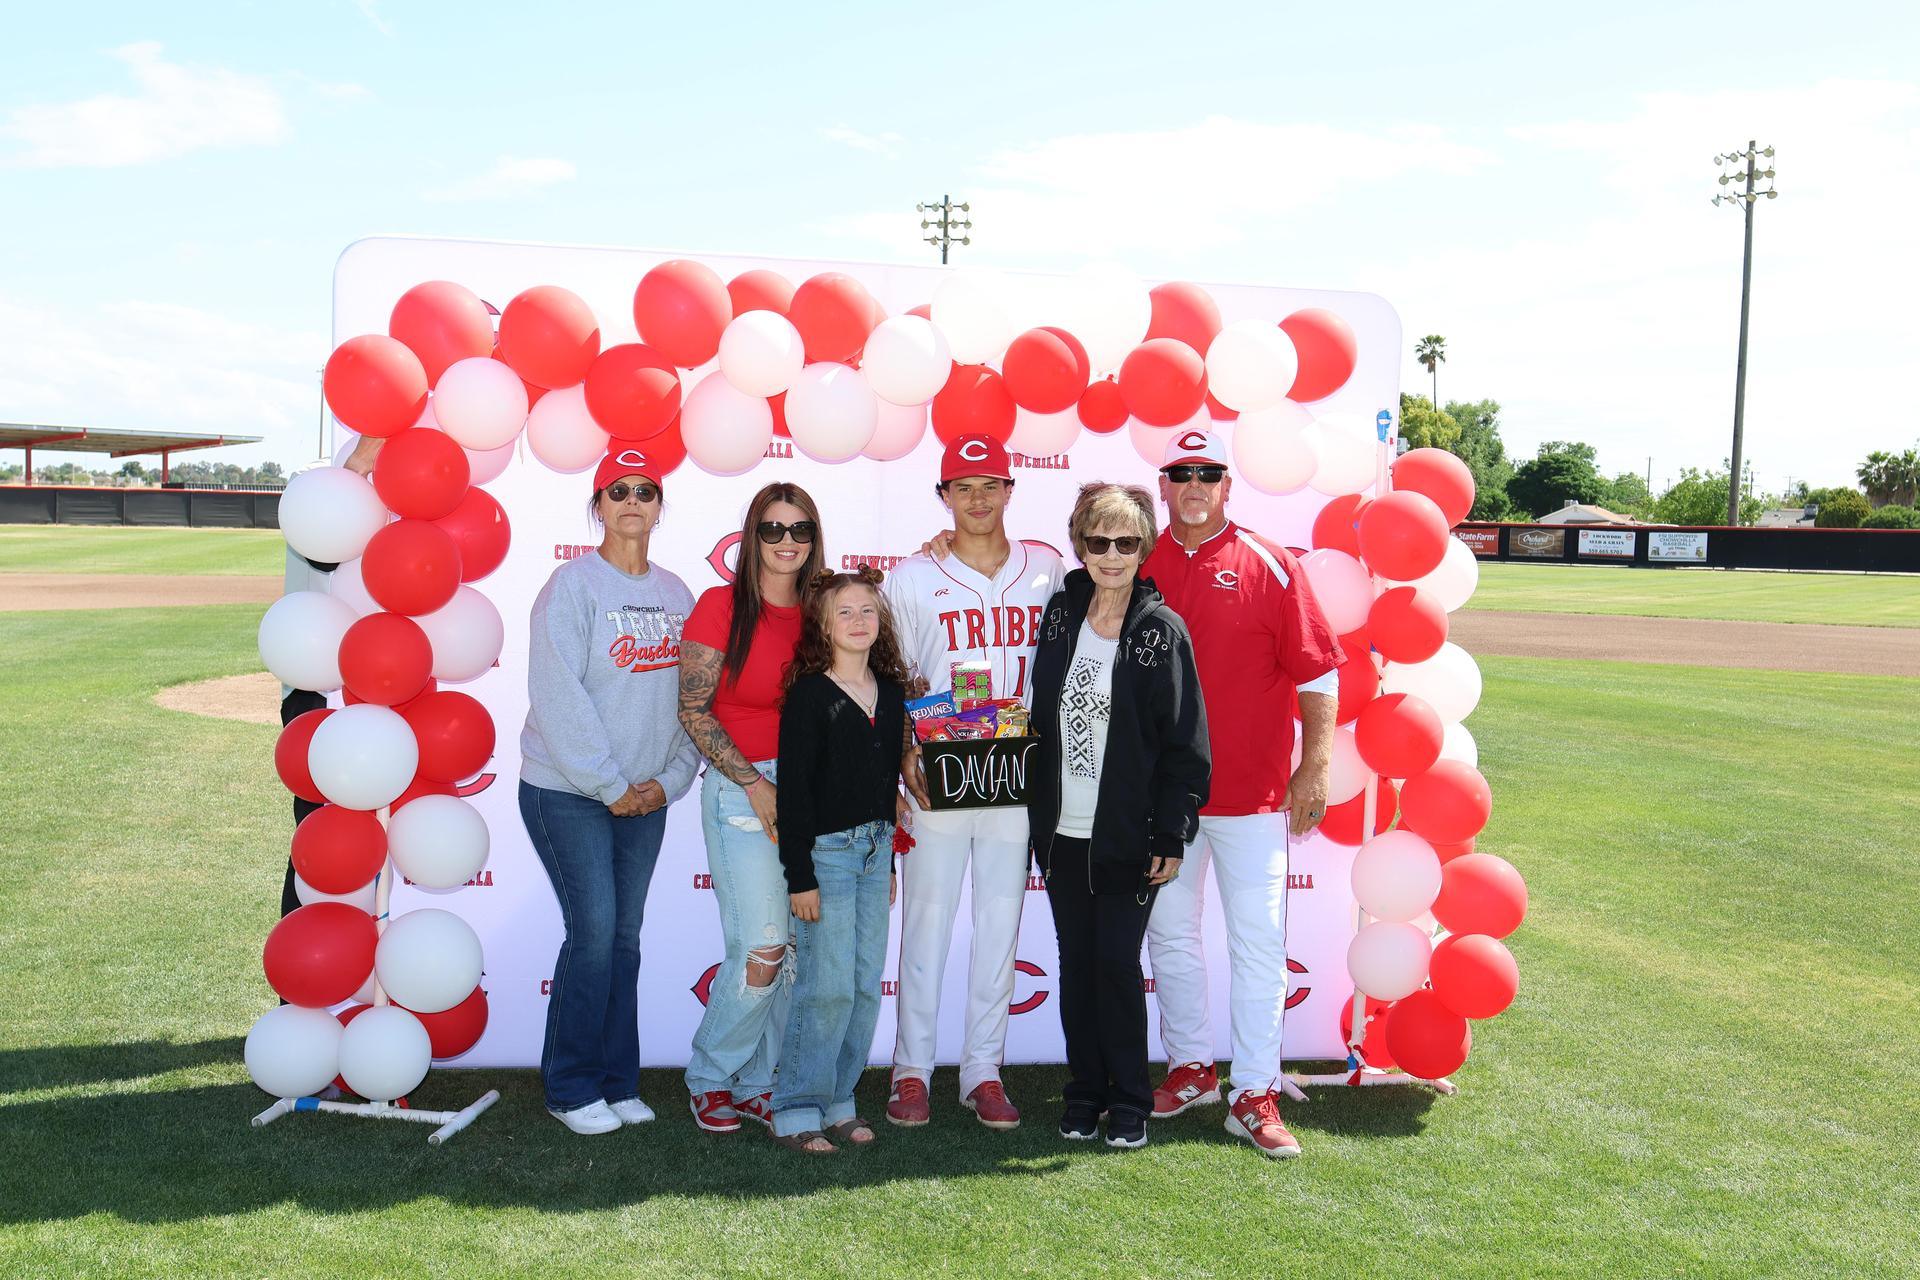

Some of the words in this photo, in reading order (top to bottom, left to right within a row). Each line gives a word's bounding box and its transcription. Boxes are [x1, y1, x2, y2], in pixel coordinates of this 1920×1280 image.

[1177, 431, 1207, 450] C
[615, 449, 646, 467] C
[959, 440, 988, 461] C
[841, 554, 907, 571] CHOWCH
[1215, 569, 1239, 587] C
[939, 605, 1043, 652] TRIBE
[608, 635, 680, 668] Baseba
[927, 702, 953, 718] VINES
[934, 742, 1038, 803] DAVIAN
